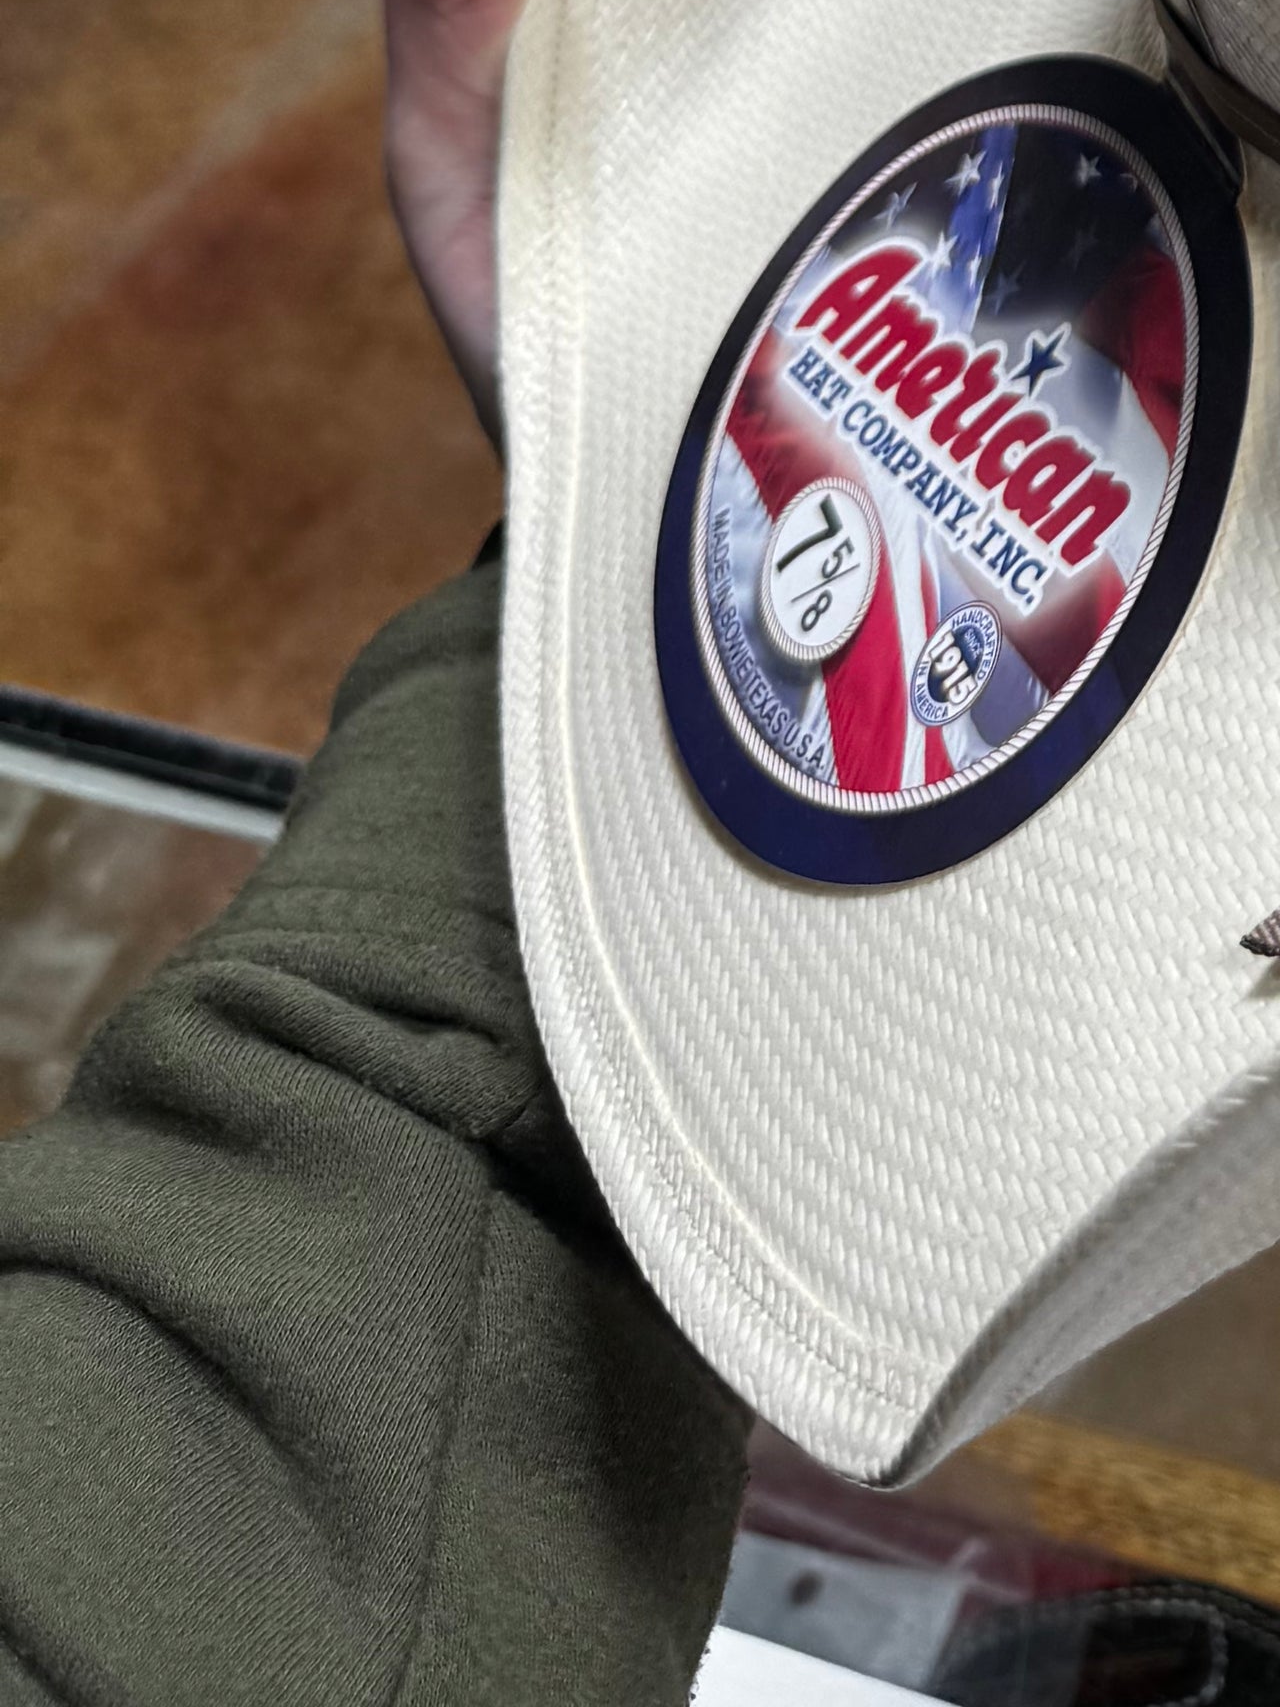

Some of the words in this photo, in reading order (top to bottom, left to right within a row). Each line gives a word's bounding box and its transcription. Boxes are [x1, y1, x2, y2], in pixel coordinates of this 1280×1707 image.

[795, 245, 1131, 566] American
[787, 345, 849, 411] HAT
[842, 398, 980, 541] COMPANY,
[970, 518, 1045, 603] INC.
[712, 507, 732, 582] MADE
[776, 493, 843, 573] 7
[720, 605, 757, 679] BOWIE
[917, 660, 930, 677] IN
[928, 629, 978, 706] 1915
[951, 608, 996, 681] HANDCRAFTED
[964, 627, 982, 660] SINCE
[743, 666, 789, 735] TEXAS
[915, 683, 949, 720] AMERICA
[784, 722, 826, 770] U.S.A.
